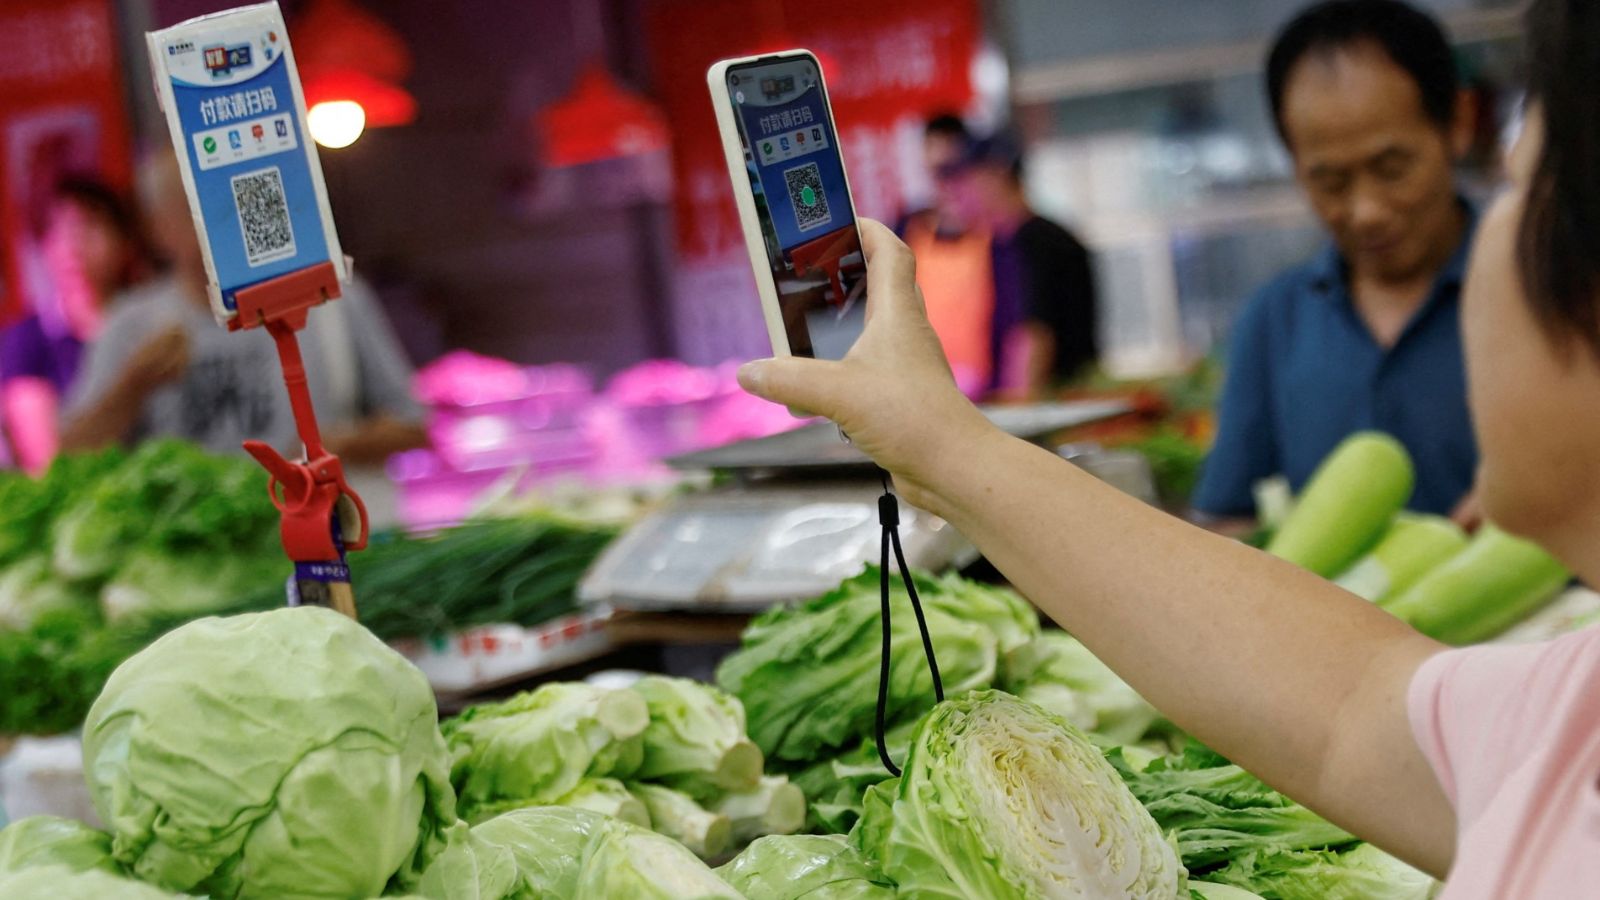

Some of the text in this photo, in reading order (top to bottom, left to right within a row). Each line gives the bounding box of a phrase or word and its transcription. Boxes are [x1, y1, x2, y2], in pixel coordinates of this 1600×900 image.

[200, 86, 277, 125] 付款请扫码
[759, 106, 814, 134] 付款请扫码
